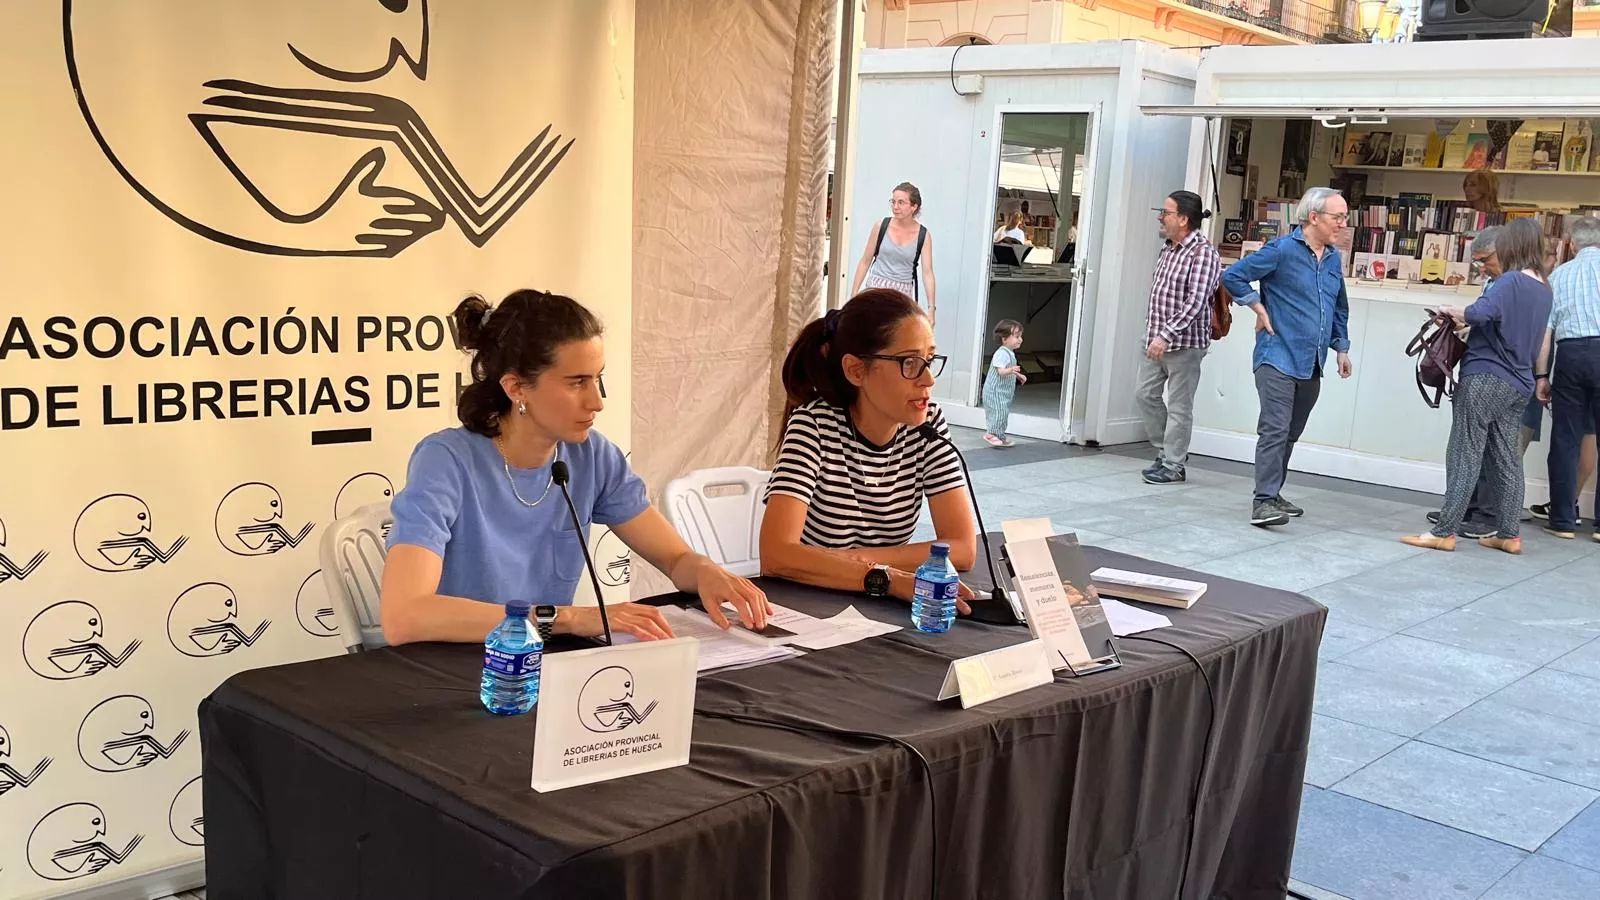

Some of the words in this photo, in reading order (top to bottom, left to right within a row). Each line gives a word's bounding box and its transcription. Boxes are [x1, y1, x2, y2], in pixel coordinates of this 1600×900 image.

[0, 306, 338, 359] ASOCIACIÓN
[357, 315, 461, 352] PROV
[1, 385, 80, 430] DE
[102, 375, 370, 425] LIBRERIAS
[386, 373, 440, 410] DE
[563, 740, 613, 756] ASOCIACIÓN
[615, 733, 660, 746] PROVINCIAL
[563, 758, 574, 766] DE
[576, 751, 617, 764] LIBRERIAS
[619, 748, 629, 756] DE
[631, 742, 662, 754] HUESCA
